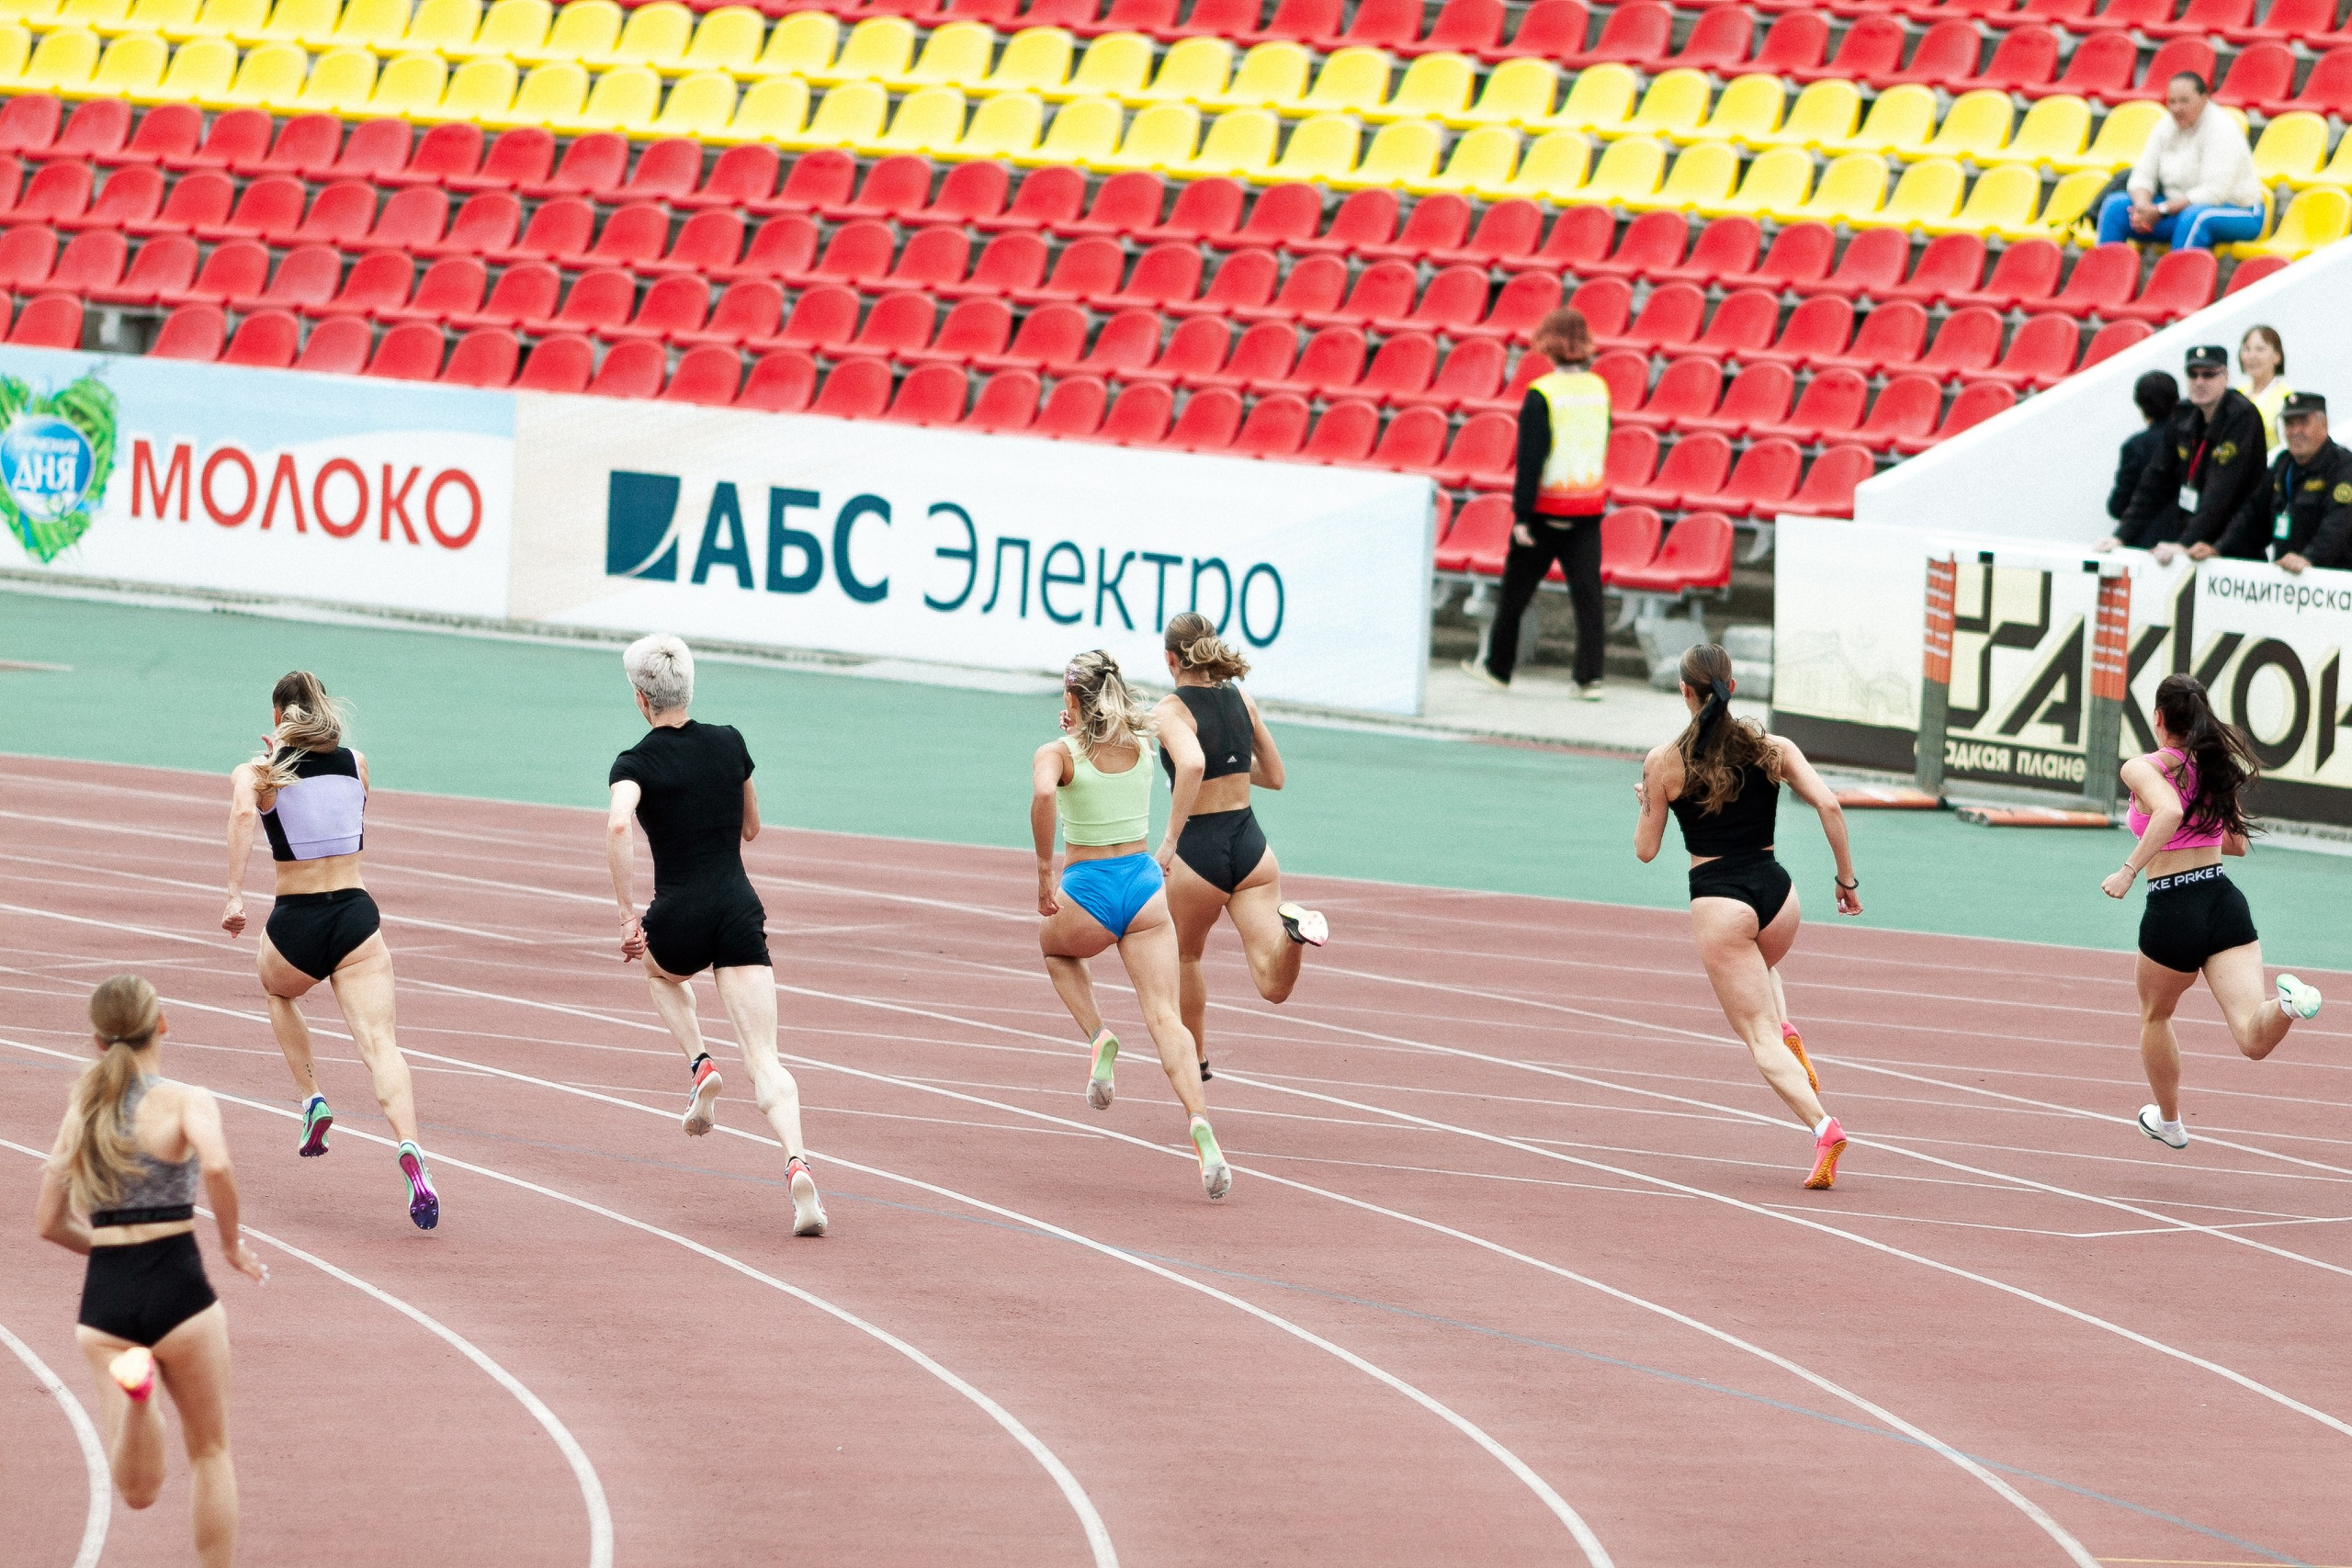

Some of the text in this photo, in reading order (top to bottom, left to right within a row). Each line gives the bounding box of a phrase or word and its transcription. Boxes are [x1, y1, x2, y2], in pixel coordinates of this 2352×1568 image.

[12, 454, 77, 494] ДНЯ
[131, 439, 482, 550] МОЛОКО
[691, 480, 1285, 649] АБС Электро
[2208, 575, 2351, 614] кондитерска
[2147, 878, 2171, 892] IKE
